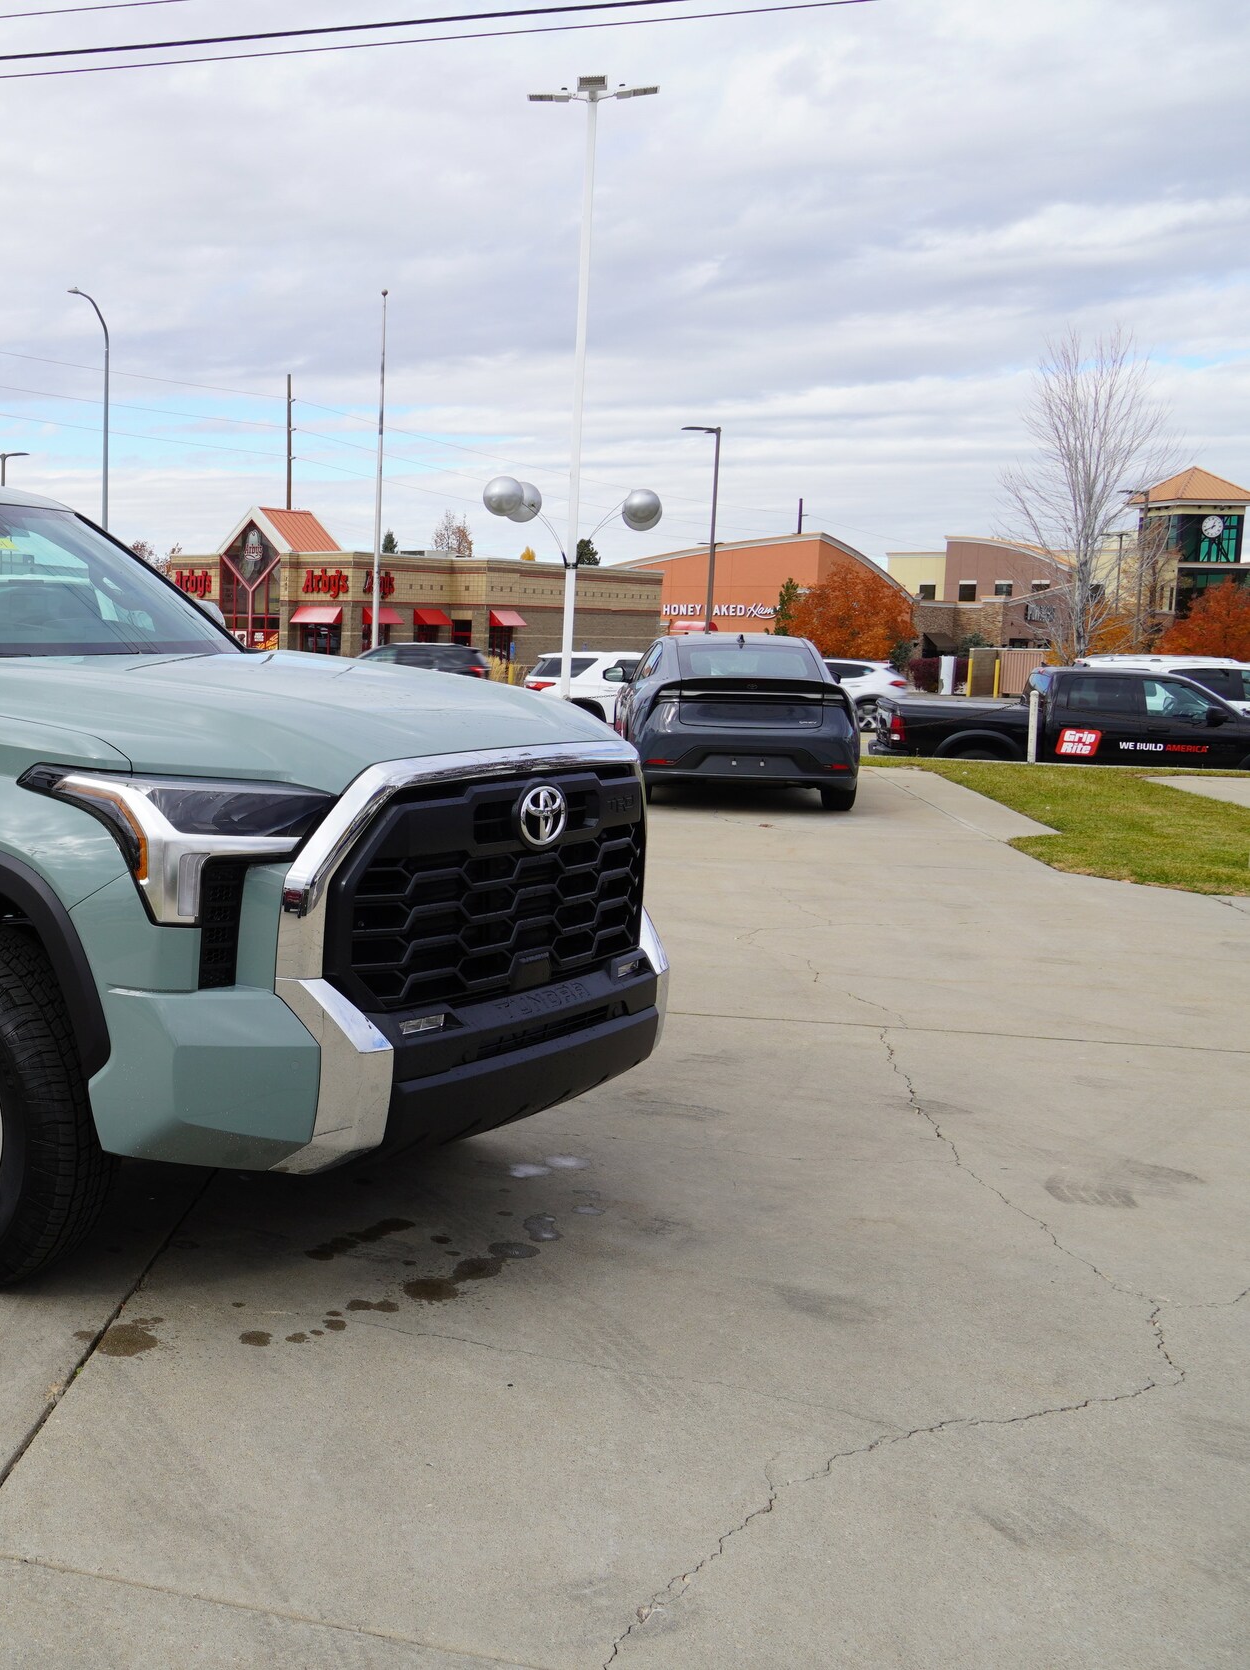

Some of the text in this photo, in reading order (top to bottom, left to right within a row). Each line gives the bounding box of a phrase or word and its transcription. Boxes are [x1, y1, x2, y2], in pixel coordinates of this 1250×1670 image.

[244, 543, 263, 557] Arby's
[174, 568, 212, 598] Arby's
[301, 568, 349, 598] Arby's
[363, 570, 395, 600] Ay's
[662, 604, 702, 616] HONEY
[704, 604, 745, 616] AKED
[1063, 730, 1096, 744] Grip
[1060, 742, 1092, 754] Rite
[1119, 742, 1135, 750] WE
[1136, 743, 1164, 751] BUILD
[493, 981, 591, 1018] TUNDRA
